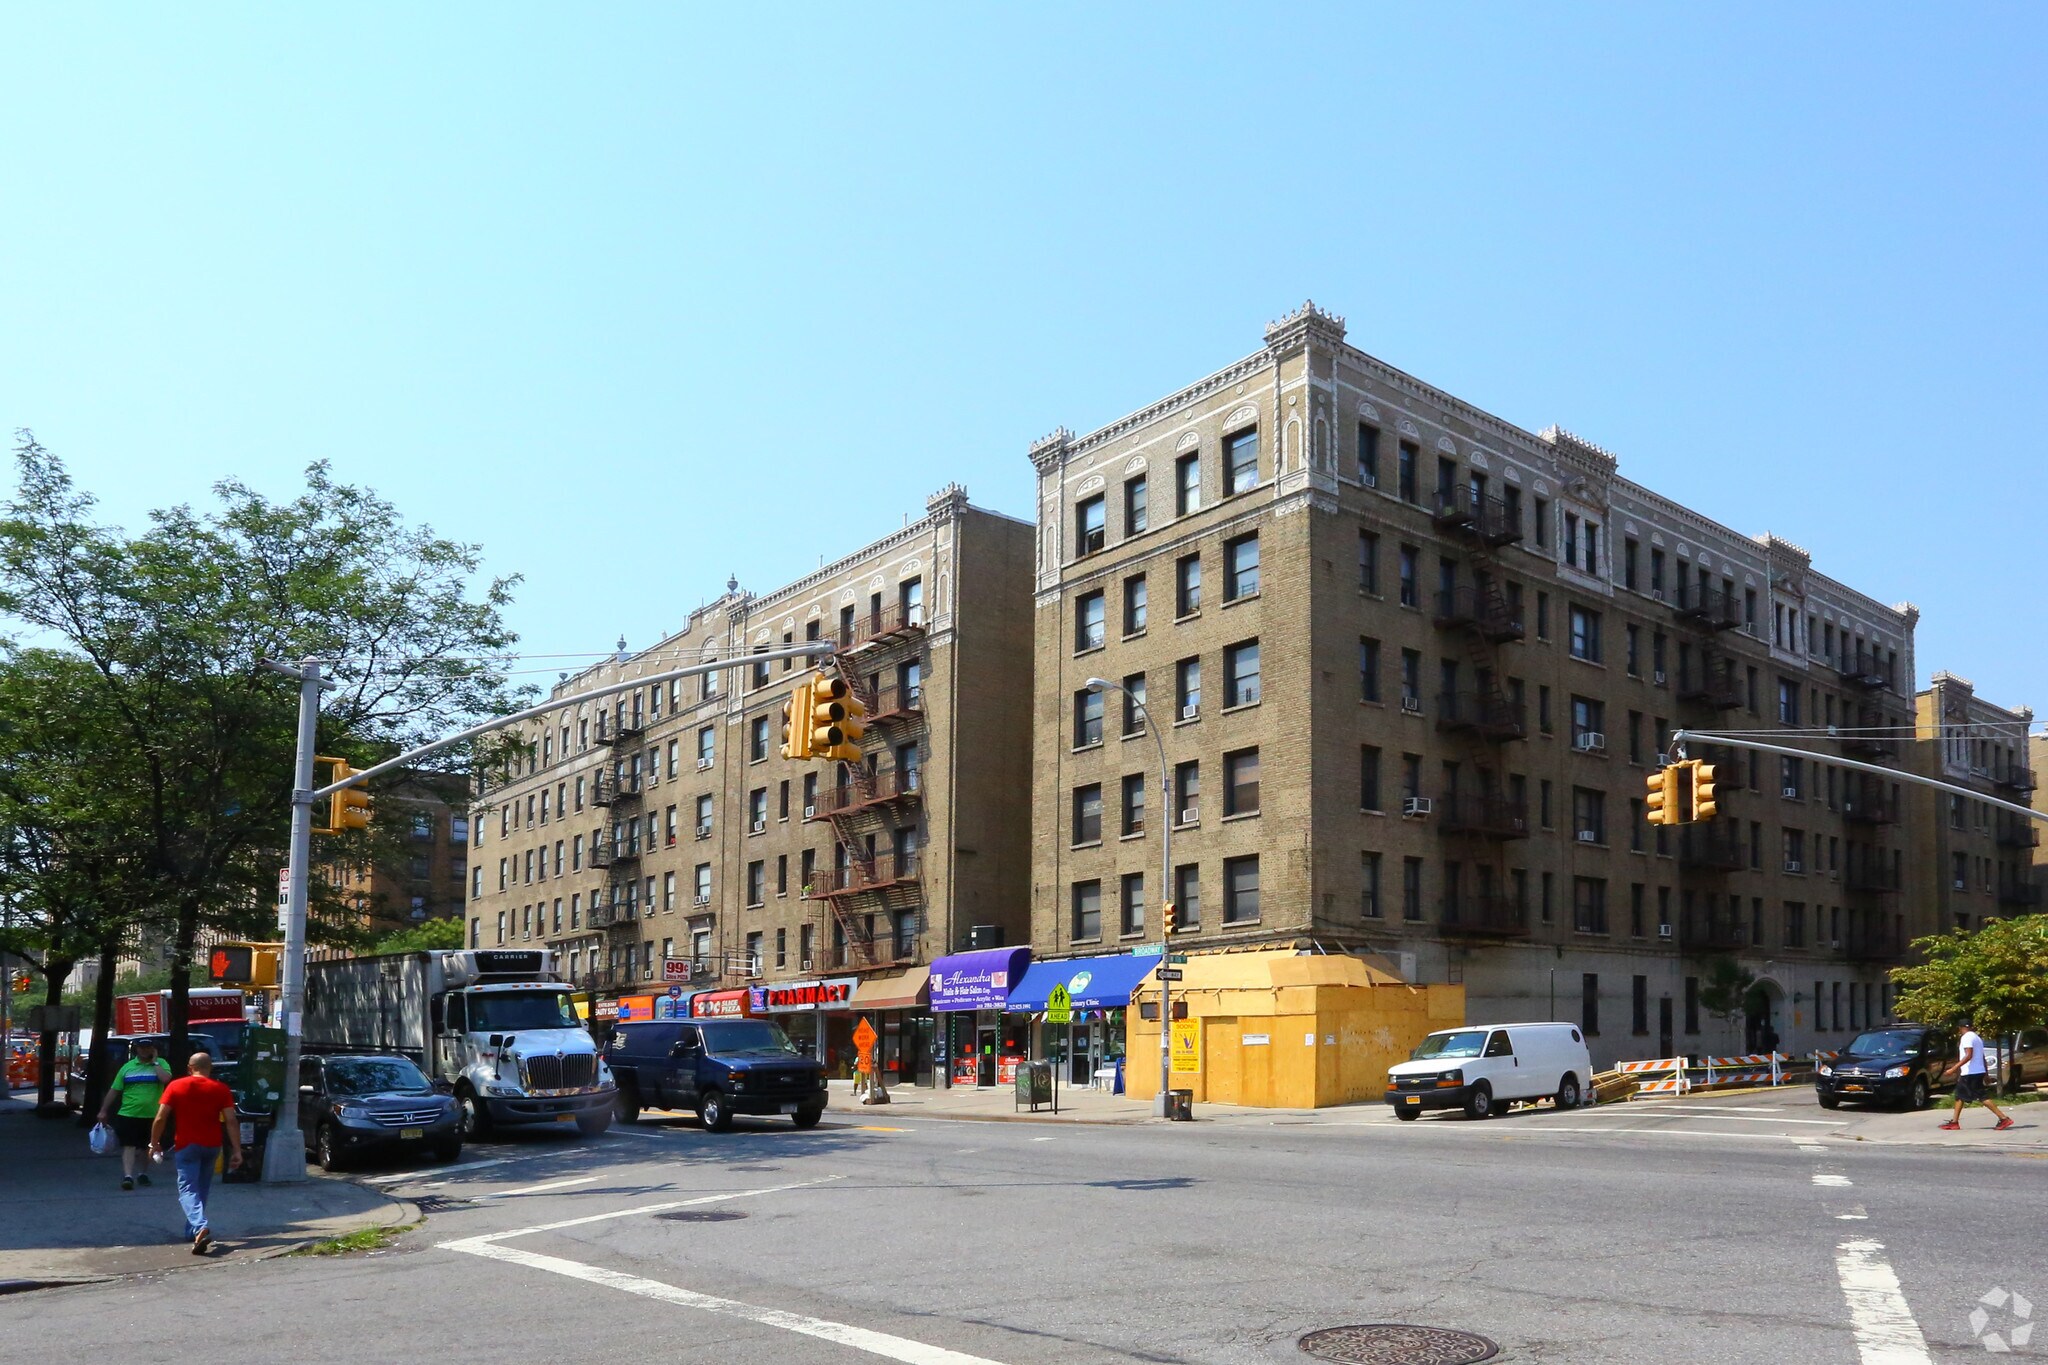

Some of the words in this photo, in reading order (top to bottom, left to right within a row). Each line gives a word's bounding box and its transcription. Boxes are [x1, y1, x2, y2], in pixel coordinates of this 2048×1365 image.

[1134, 946, 1161, 955] BROADWAY
[943, 969, 991, 985] Alexandra
[769, 984, 848, 1005] PHARMACY
[943, 988, 954, 996] Nails
[959, 986, 969, 995] Hair
[969, 985, 982, 994] Salon
[1085, 998, 1100, 1006] Clinic
[721, 1005, 741, 1013] PIZZA
